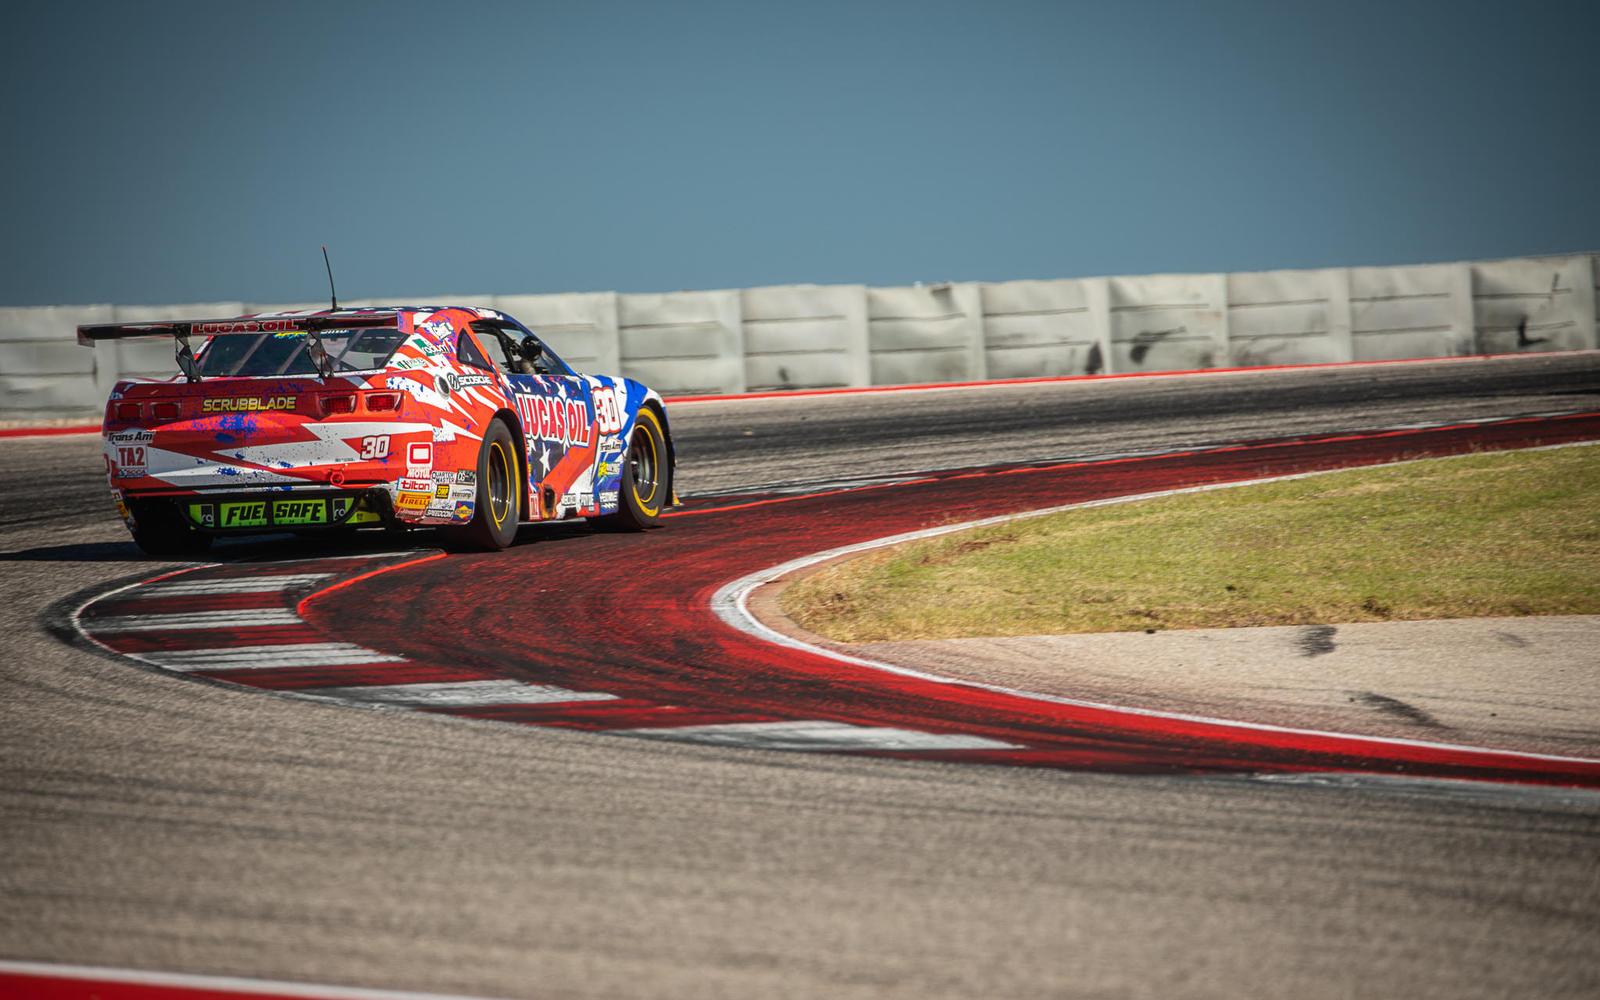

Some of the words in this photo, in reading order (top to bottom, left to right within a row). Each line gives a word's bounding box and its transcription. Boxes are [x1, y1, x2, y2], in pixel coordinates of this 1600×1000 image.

[191, 322, 259, 335] LUCAS
[263, 319, 299, 333] OIL
[202, 396, 297, 412] SCRUBBLADE
[593, 387, 622, 435] 30
[515, 394, 566, 443] LUCAS
[566, 398, 591, 446] OIL
[108, 431, 133, 442] Trans
[134, 431, 153, 441] Am
[361, 434, 391, 460] 30
[118, 447, 145, 467] TA2
[406, 468, 431, 478] MOTUL
[401, 480, 430, 491] tilton
[274, 502, 323, 522] SAFE
